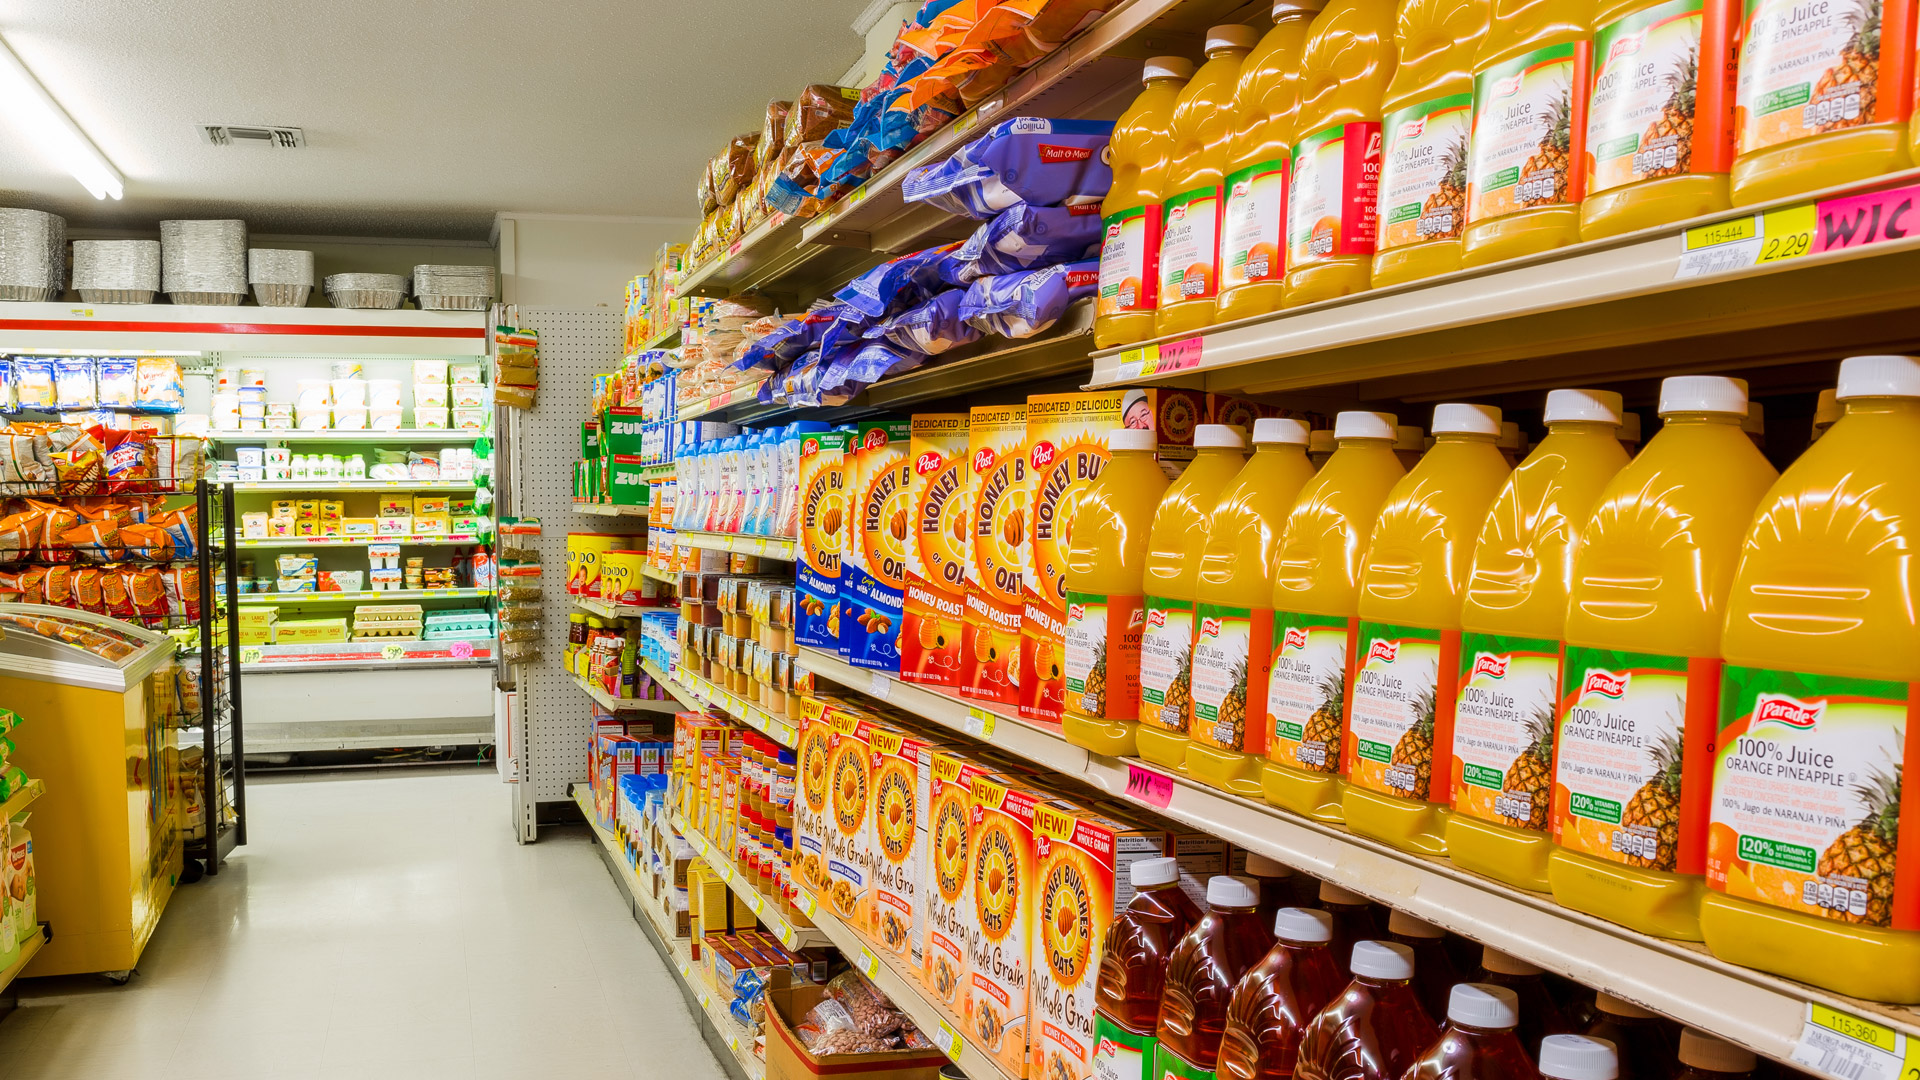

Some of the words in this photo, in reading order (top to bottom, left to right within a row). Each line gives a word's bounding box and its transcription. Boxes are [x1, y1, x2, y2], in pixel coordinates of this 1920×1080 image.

[1782, 16, 1832, 41] PINEAPPLE
[1779, 58, 1809, 72] NARANJA
[1818, 48, 1835, 60] PIÑA
[1505, 103, 1531, 120] Juice
[1017, 122, 1045, 132] million
[1500, 115, 1533, 132] PINEAPPLE
[1405, 157, 1435, 171] PINEAPPLE
[1704, 225, 1742, 245] 115-444
[1824, 198, 1912, 251] WIC
[1764, 232, 1809, 261] 2.29
[1160, 349, 1183, 371] WIC
[1029, 402, 1070, 413] DEDICATED
[1076, 399, 1121, 410] DELICIOUS
[913, 420, 958, 428] DEDICATED
[972, 412, 1010, 422] DEDICATED
[804, 442, 816, 456] Post
[867, 432, 885, 448] Post
[918, 455, 940, 472] Post
[975, 452, 993, 470] Post
[1033, 445, 1053, 467] Post
[806, 475, 826, 527] HONEY
[866, 471, 896, 531] HONEY
[923, 466, 960, 533] HONEY
[978, 463, 1010, 535] HONEY
[1037, 458, 1071, 539] HONEY
[932, 552, 942, 565] OF
[986, 557, 994, 570] OF
[1046, 563, 1055, 578] OF
[908, 586, 935, 607] HONEY
[936, 598, 963, 616] ROAST
[966, 594, 989, 615] HONEY
[1025, 603, 1049, 628] HONEY
[1278, 657, 1293, 670] 100%
[1294, 661, 1310, 673] Juice
[1477, 659, 1502, 674] Parade
[1274, 670, 1290, 680] ORANGE
[1291, 674, 1314, 685] PINEAPPLE
[1361, 670, 1380, 685] 100%
[1381, 675, 1402, 689] Juice
[1588, 677, 1619, 693] Parade
[1355, 684, 1376, 696] ORANGE
[1377, 689, 1406, 702] PINEAPPLE
[1465, 688, 1488, 704] 100%
[1490, 692, 1513, 708] Juice
[801, 700, 820, 717] NEW!
[1459, 703, 1483, 716] ORANGE
[1485, 707, 1519, 722] PINEAPPLE
[1762, 702, 1810, 724] Parade
[830, 715, 852, 732] NEW!
[1572, 708, 1600, 726] 100%
[1604, 713, 1635, 732] Juice
[858, 729, 869, 738] WHOLE
[871, 733, 896, 751] NEW!
[1563, 725, 1595, 740] ORANGE
[1597, 730, 1641, 748] PINEAPPLE
[805, 738, 815, 771] HONEY
[903, 748, 915, 757] WHOLE
[1739, 738, 1782, 760] 100%
[1787, 745, 1834, 768] Juice
[836, 757, 847, 791] HONEY
[849, 752, 864, 801] BUNCHES
[933, 757, 955, 778] NEW!
[1586, 767, 1594, 775] de
[1594, 768, 1622, 780] NARANJA
[1628, 772, 1642, 785] PIÑA
[1726, 757, 1773, 775] ORANGE
[1777, 765, 1844, 786] PINEAPPLE
[971, 783, 998, 804] NEW!
[1129, 770, 1152, 796] WIC
[809, 790, 821, 804] OATS
[879, 774, 892, 814] HONEY
[894, 773, 912, 825] BUNCHES
[1006, 801, 1020, 813] WHOLE
[1572, 795, 1593, 811] 120%
[796, 803, 814, 834] Whole
[840, 811, 854, 827] OATS
[973, 806, 984, 823] Post
[1035, 812, 1067, 836] NEW!
[1722, 798, 1740, 809] 100%
[1742, 802, 1760, 814] Jugo
[1762, 807, 1772, 815] de
[1774, 808, 1814, 823] NARANJA
[1817, 815, 1822, 823] Y
[1825, 815, 1846, 829] PIÑA
[937, 803, 949, 848] HONEY
[951, 802, 967, 860] BUNCHES
[886, 836, 903, 853] OATS
[1037, 837, 1050, 856] Post
[1076, 834, 1094, 847] WHOLE
[1094, 839, 1110, 854] GRAIN
[1742, 837, 1774, 857] 120%
[1776, 844, 1805, 857] VITAMIN
[1807, 850, 1813, 858] C
[870, 852, 893, 887] Whole
[977, 835, 992, 882] HONEY
[995, 831, 1015, 896] BUNCHES
[942, 872, 956, 892] OATS
[927, 889, 946, 932] Whole
[1045, 866, 1061, 921] HONEY
[1065, 864, 1088, 939] BUNCHES
[984, 907, 1002, 930] OATS
[966, 926, 990, 974] Whole
[993, 947, 1024, 989] Grain
[1053, 951, 1074, 976] OATS
[974, 976, 987, 989] HONEY
[988, 982, 1007, 1004] CRUNCH
[1032, 969, 1063, 1020] Whole
[1832, 1016, 1877, 1042] 115-360
[1045, 1024, 1060, 1040] HONEY
[1060, 1033, 1082, 1057] CRUNCH
